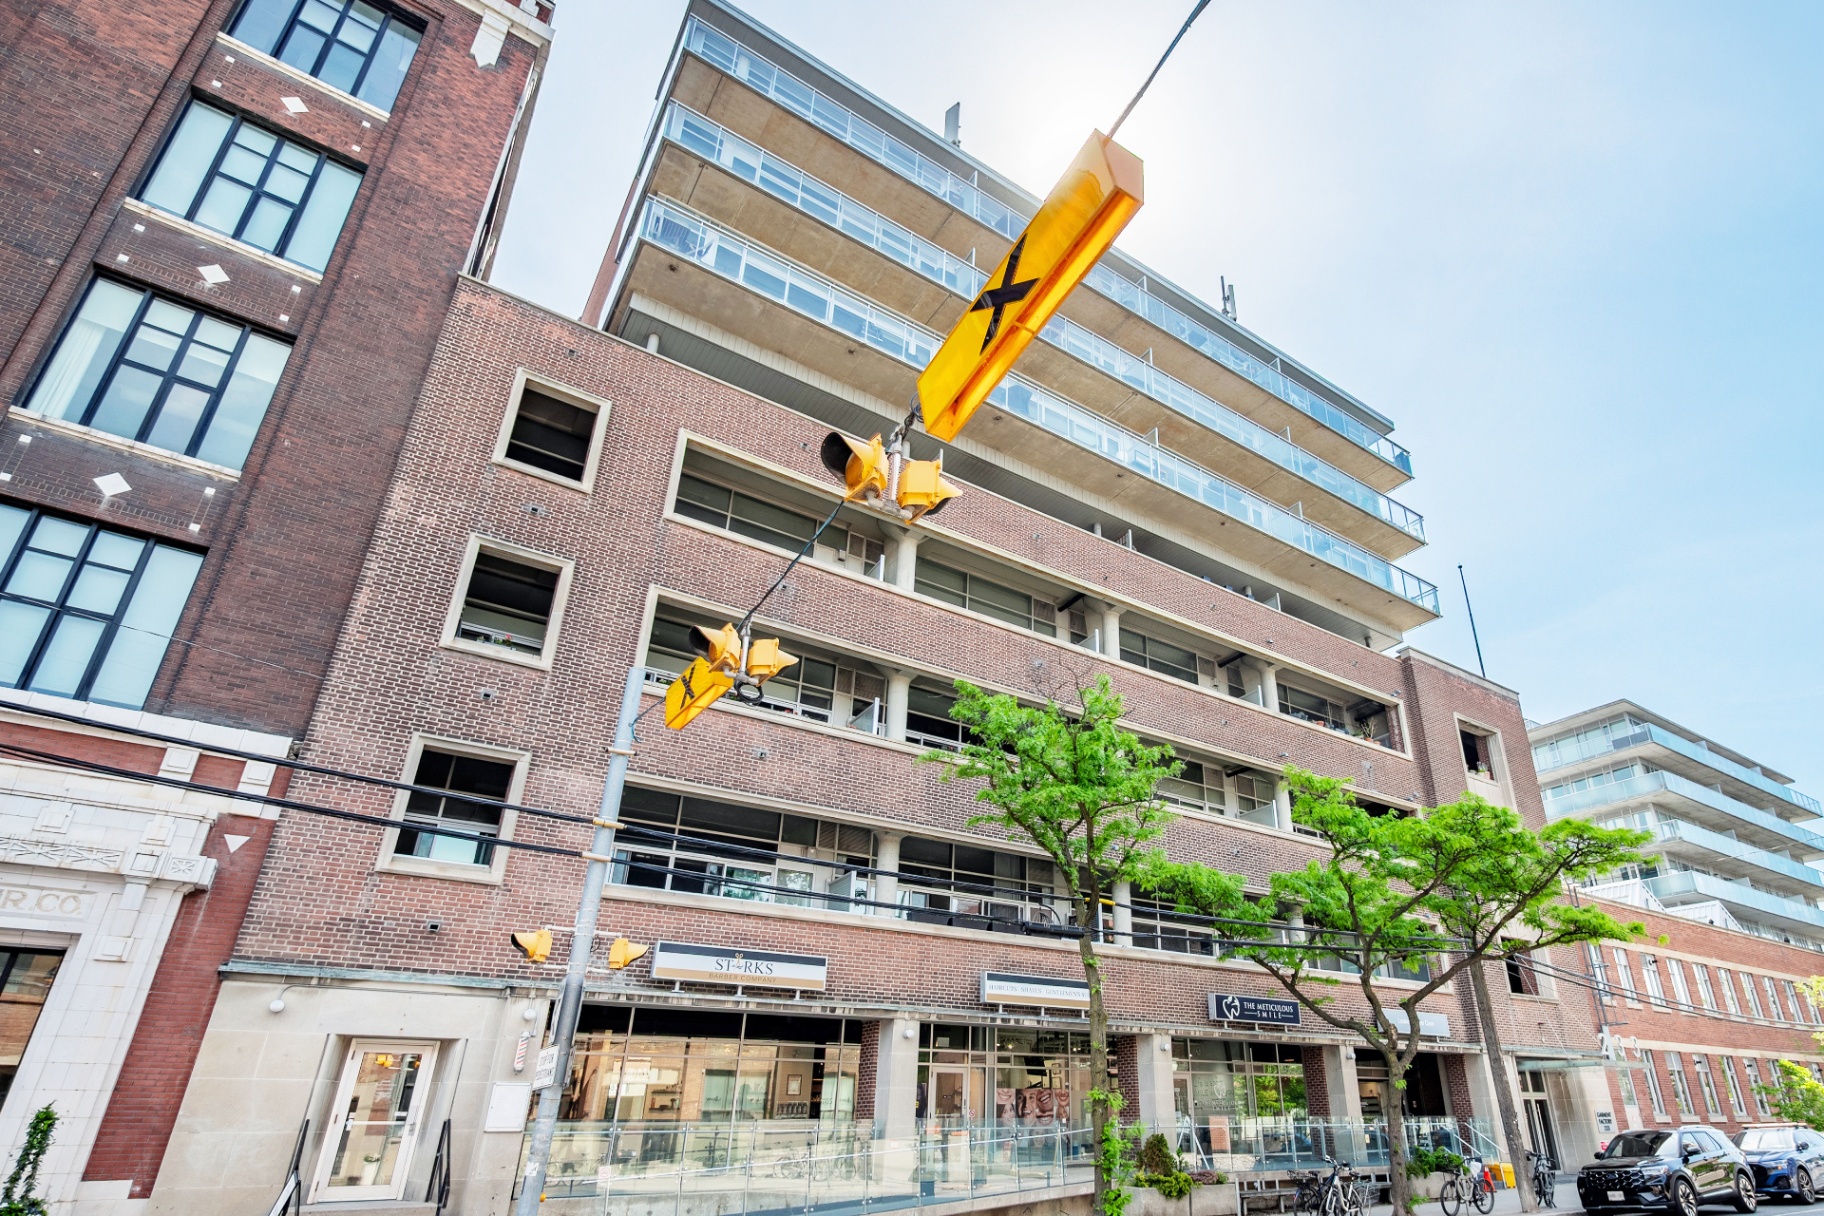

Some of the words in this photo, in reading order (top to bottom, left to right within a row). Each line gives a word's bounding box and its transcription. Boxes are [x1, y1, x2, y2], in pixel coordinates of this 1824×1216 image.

[0, 889, 33, 911] R.
[708, 972, 738, 981] BARBER
[740, 975, 777, 984] COMPANY
[989, 984, 1018, 992] HAIRCUTS
[1243, 1001, 1256, 1010] THE
[1256, 1003, 1294, 1013] METICULOUS
[1256, 1011, 1282, 1019] SMILE
